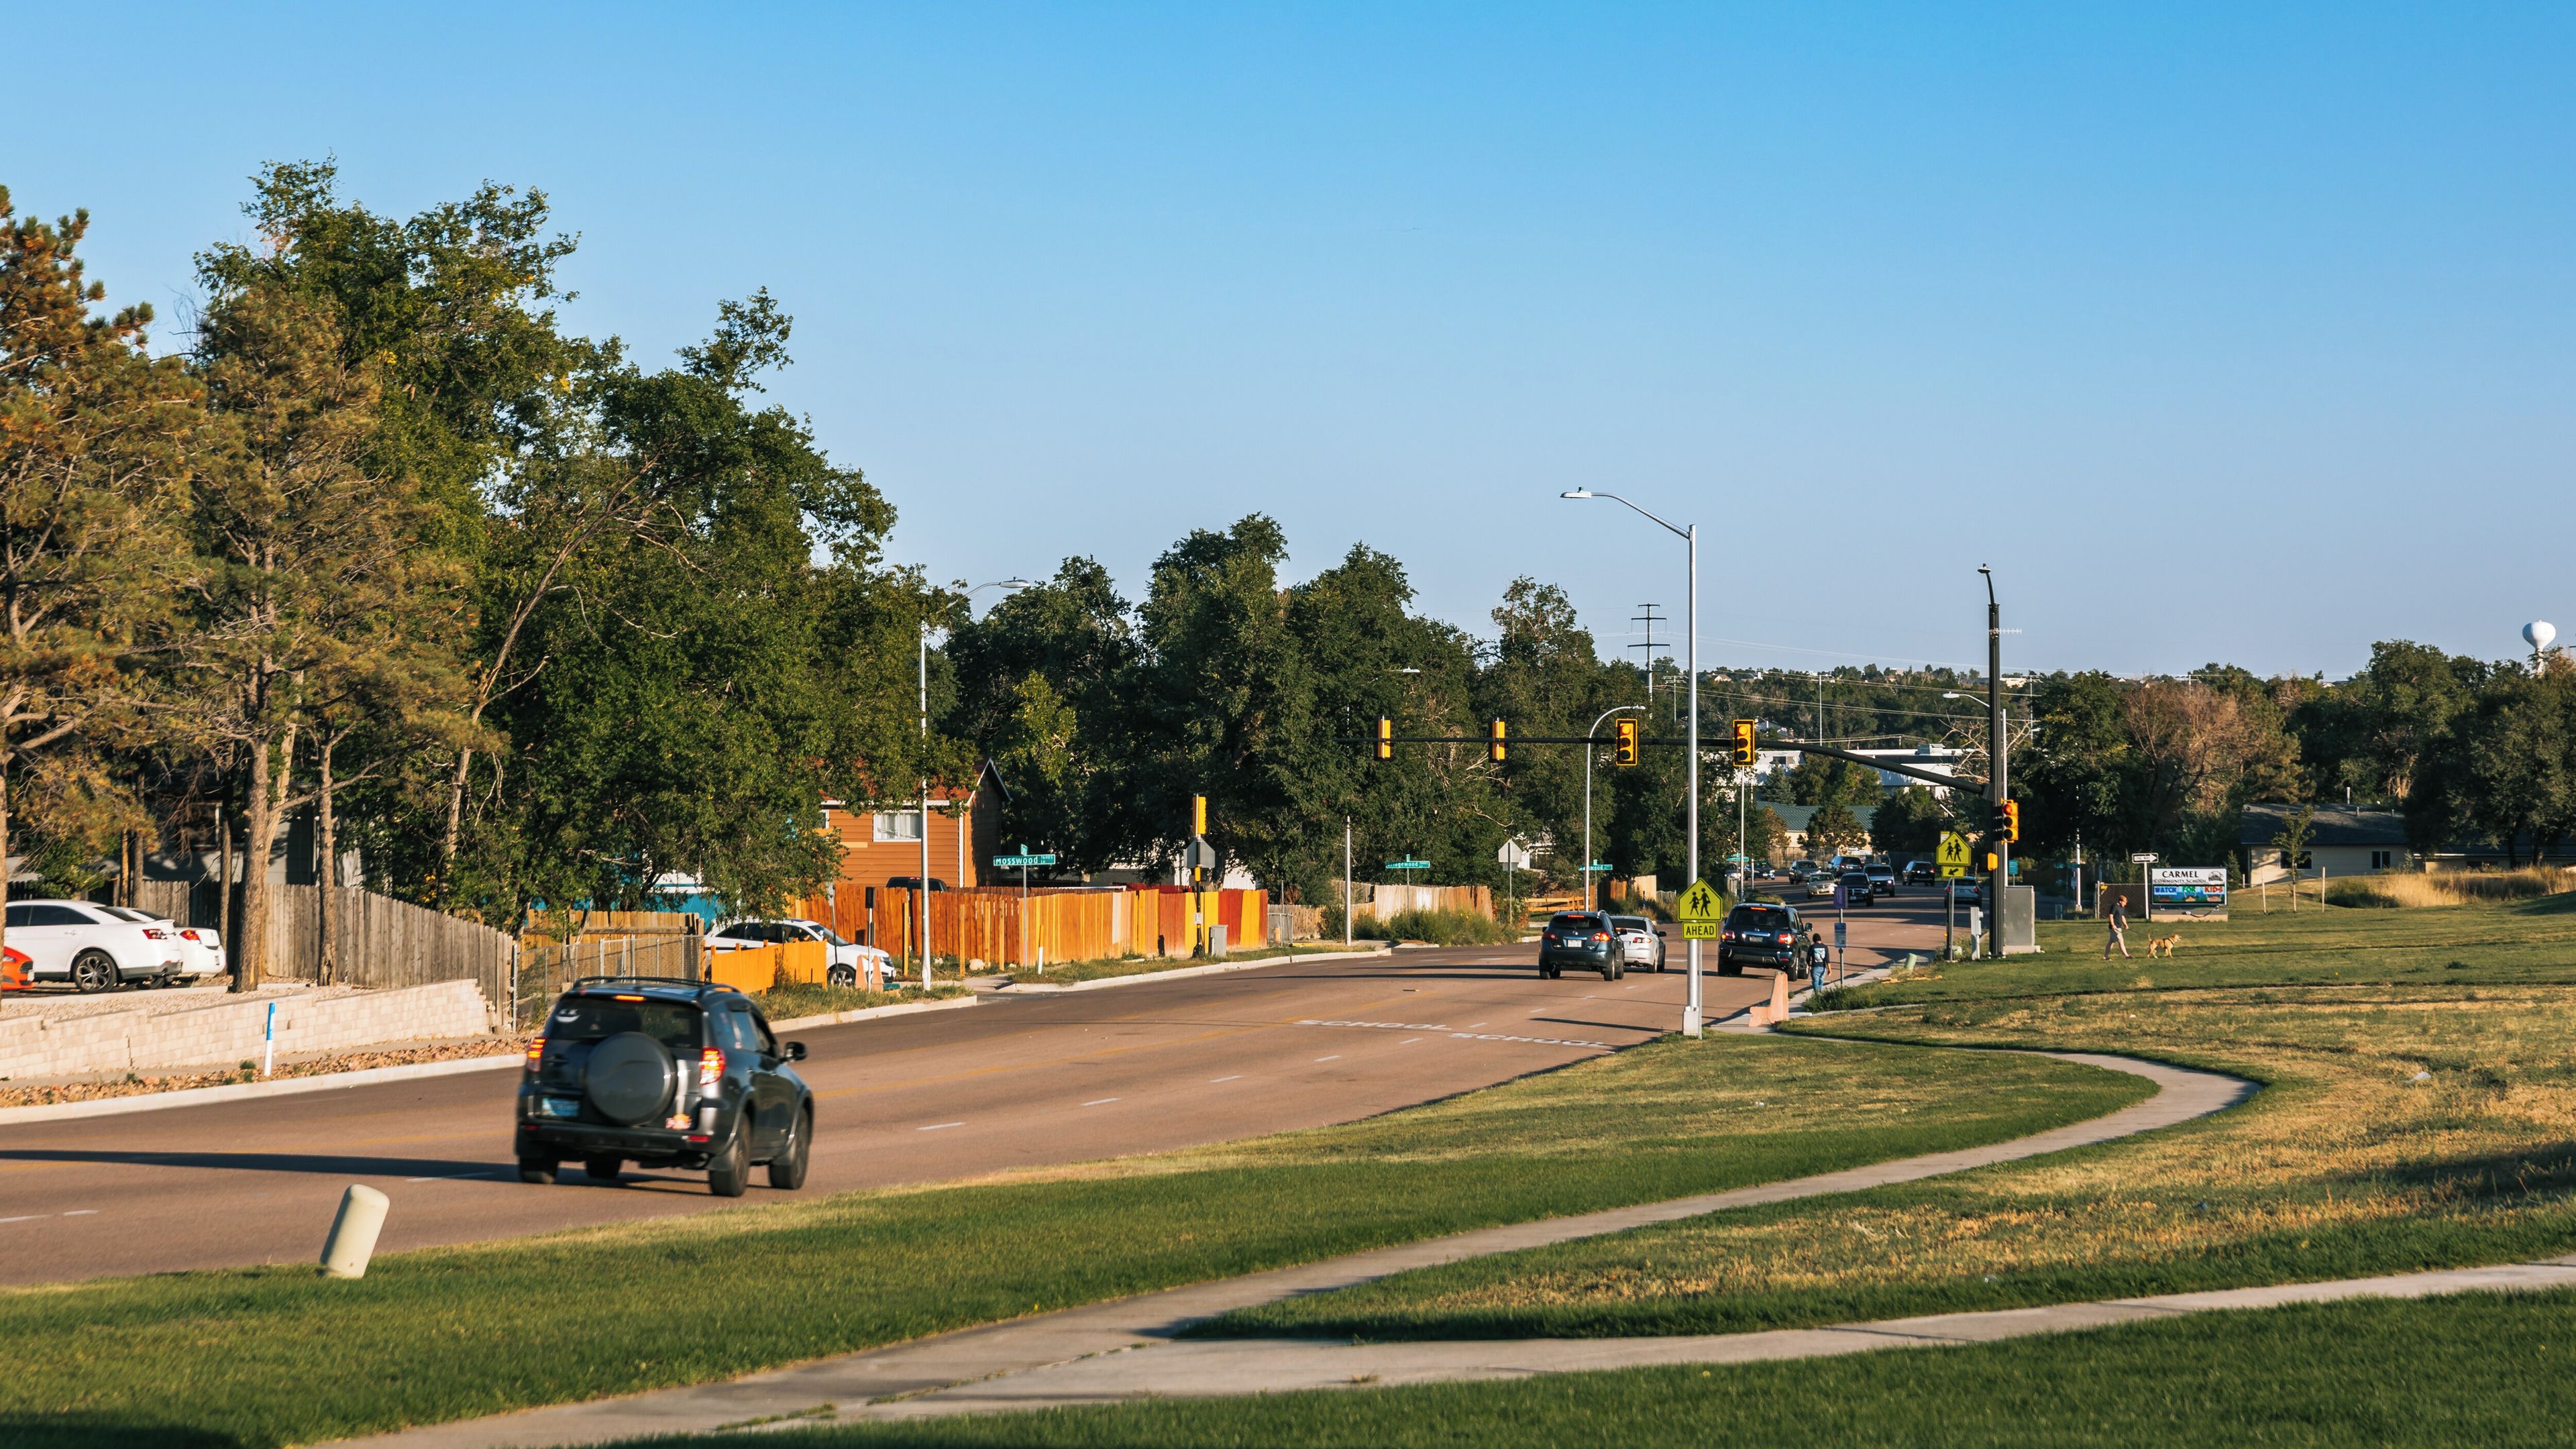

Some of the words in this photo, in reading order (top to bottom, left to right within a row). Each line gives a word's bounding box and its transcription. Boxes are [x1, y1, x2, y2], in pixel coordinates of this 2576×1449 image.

[1686, 926, 1715, 935] AHEAD
[1292, 1020, 1452, 1030] SCHOOL
[1448, 1033, 1613, 1047] SCHOOL
